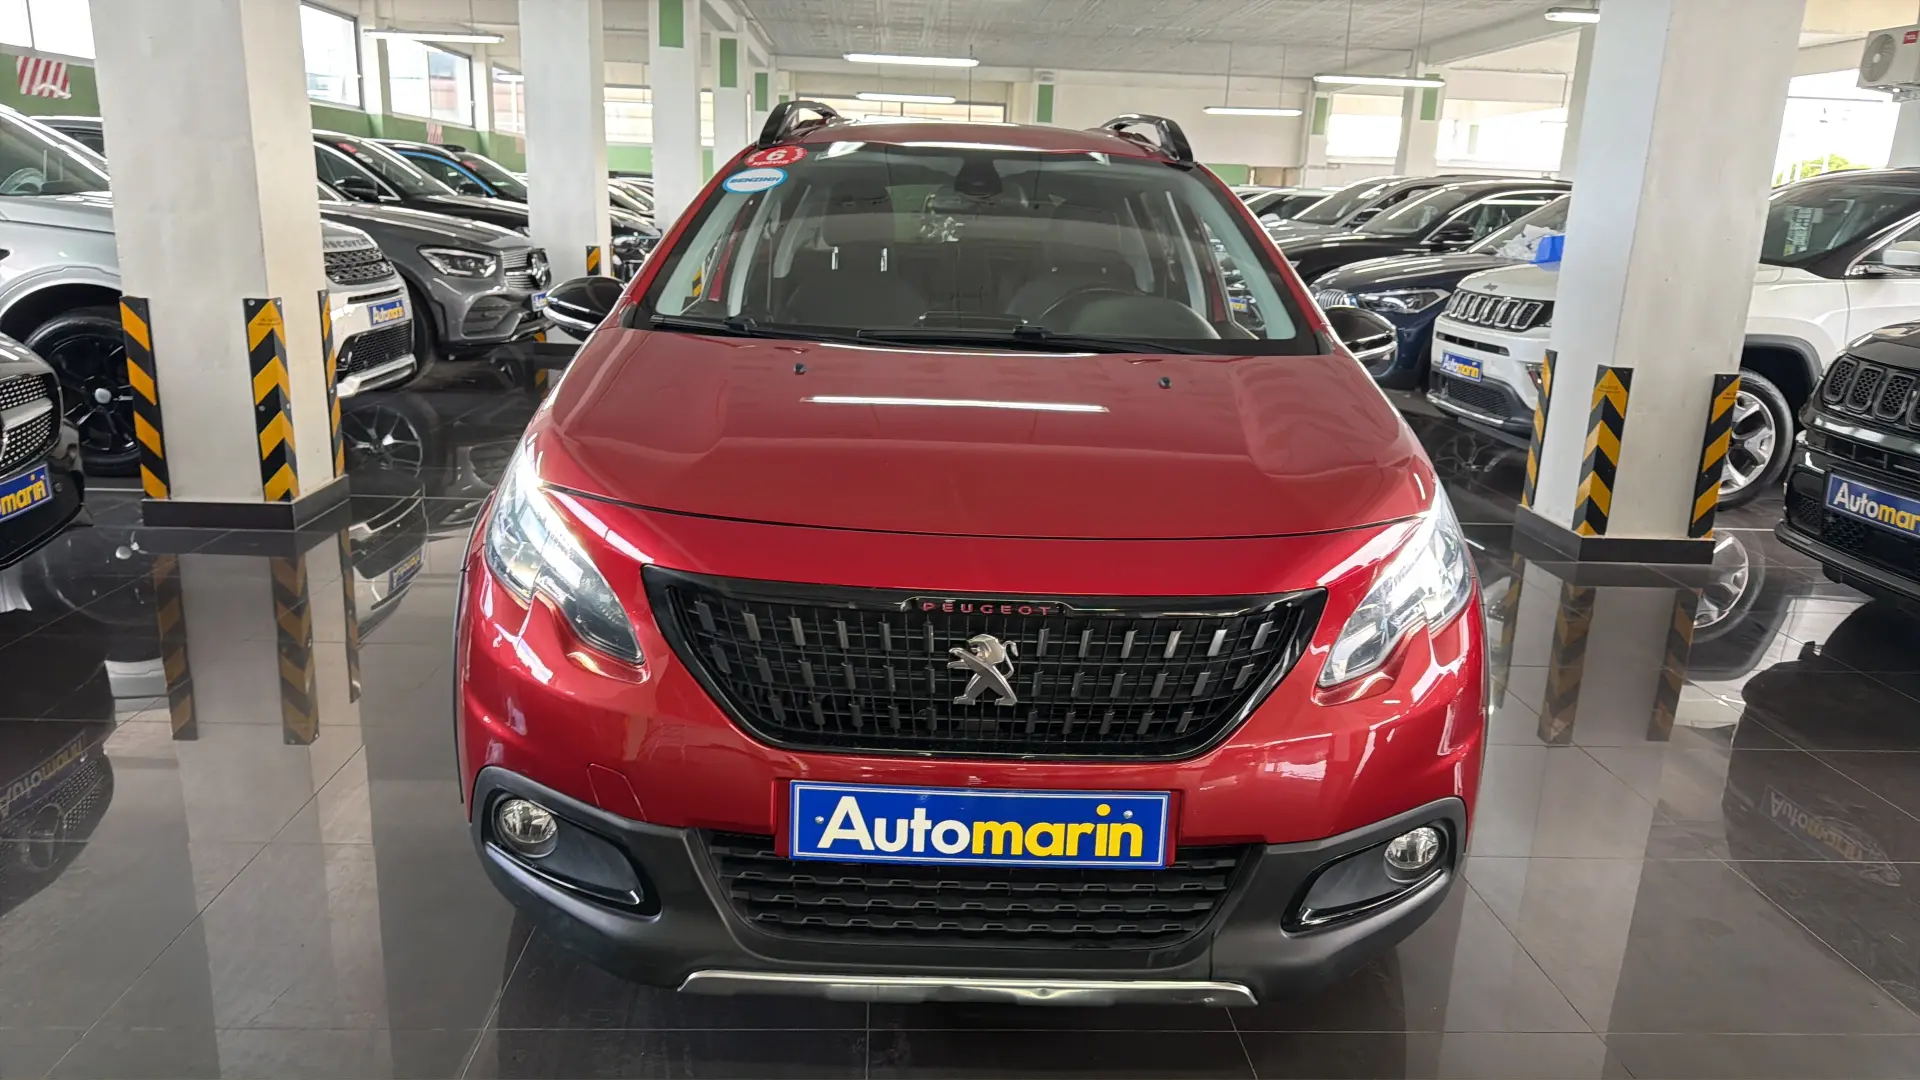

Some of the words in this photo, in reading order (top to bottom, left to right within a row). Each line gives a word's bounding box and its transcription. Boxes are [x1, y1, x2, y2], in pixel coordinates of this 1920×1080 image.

[766, 149, 788, 161] 6
[0, 473, 47, 516] marin
[1832, 481, 1920, 532] Automar
[922, 602, 1051, 616] PEUGEOT
[816, 795, 1143, 857] Automarin
